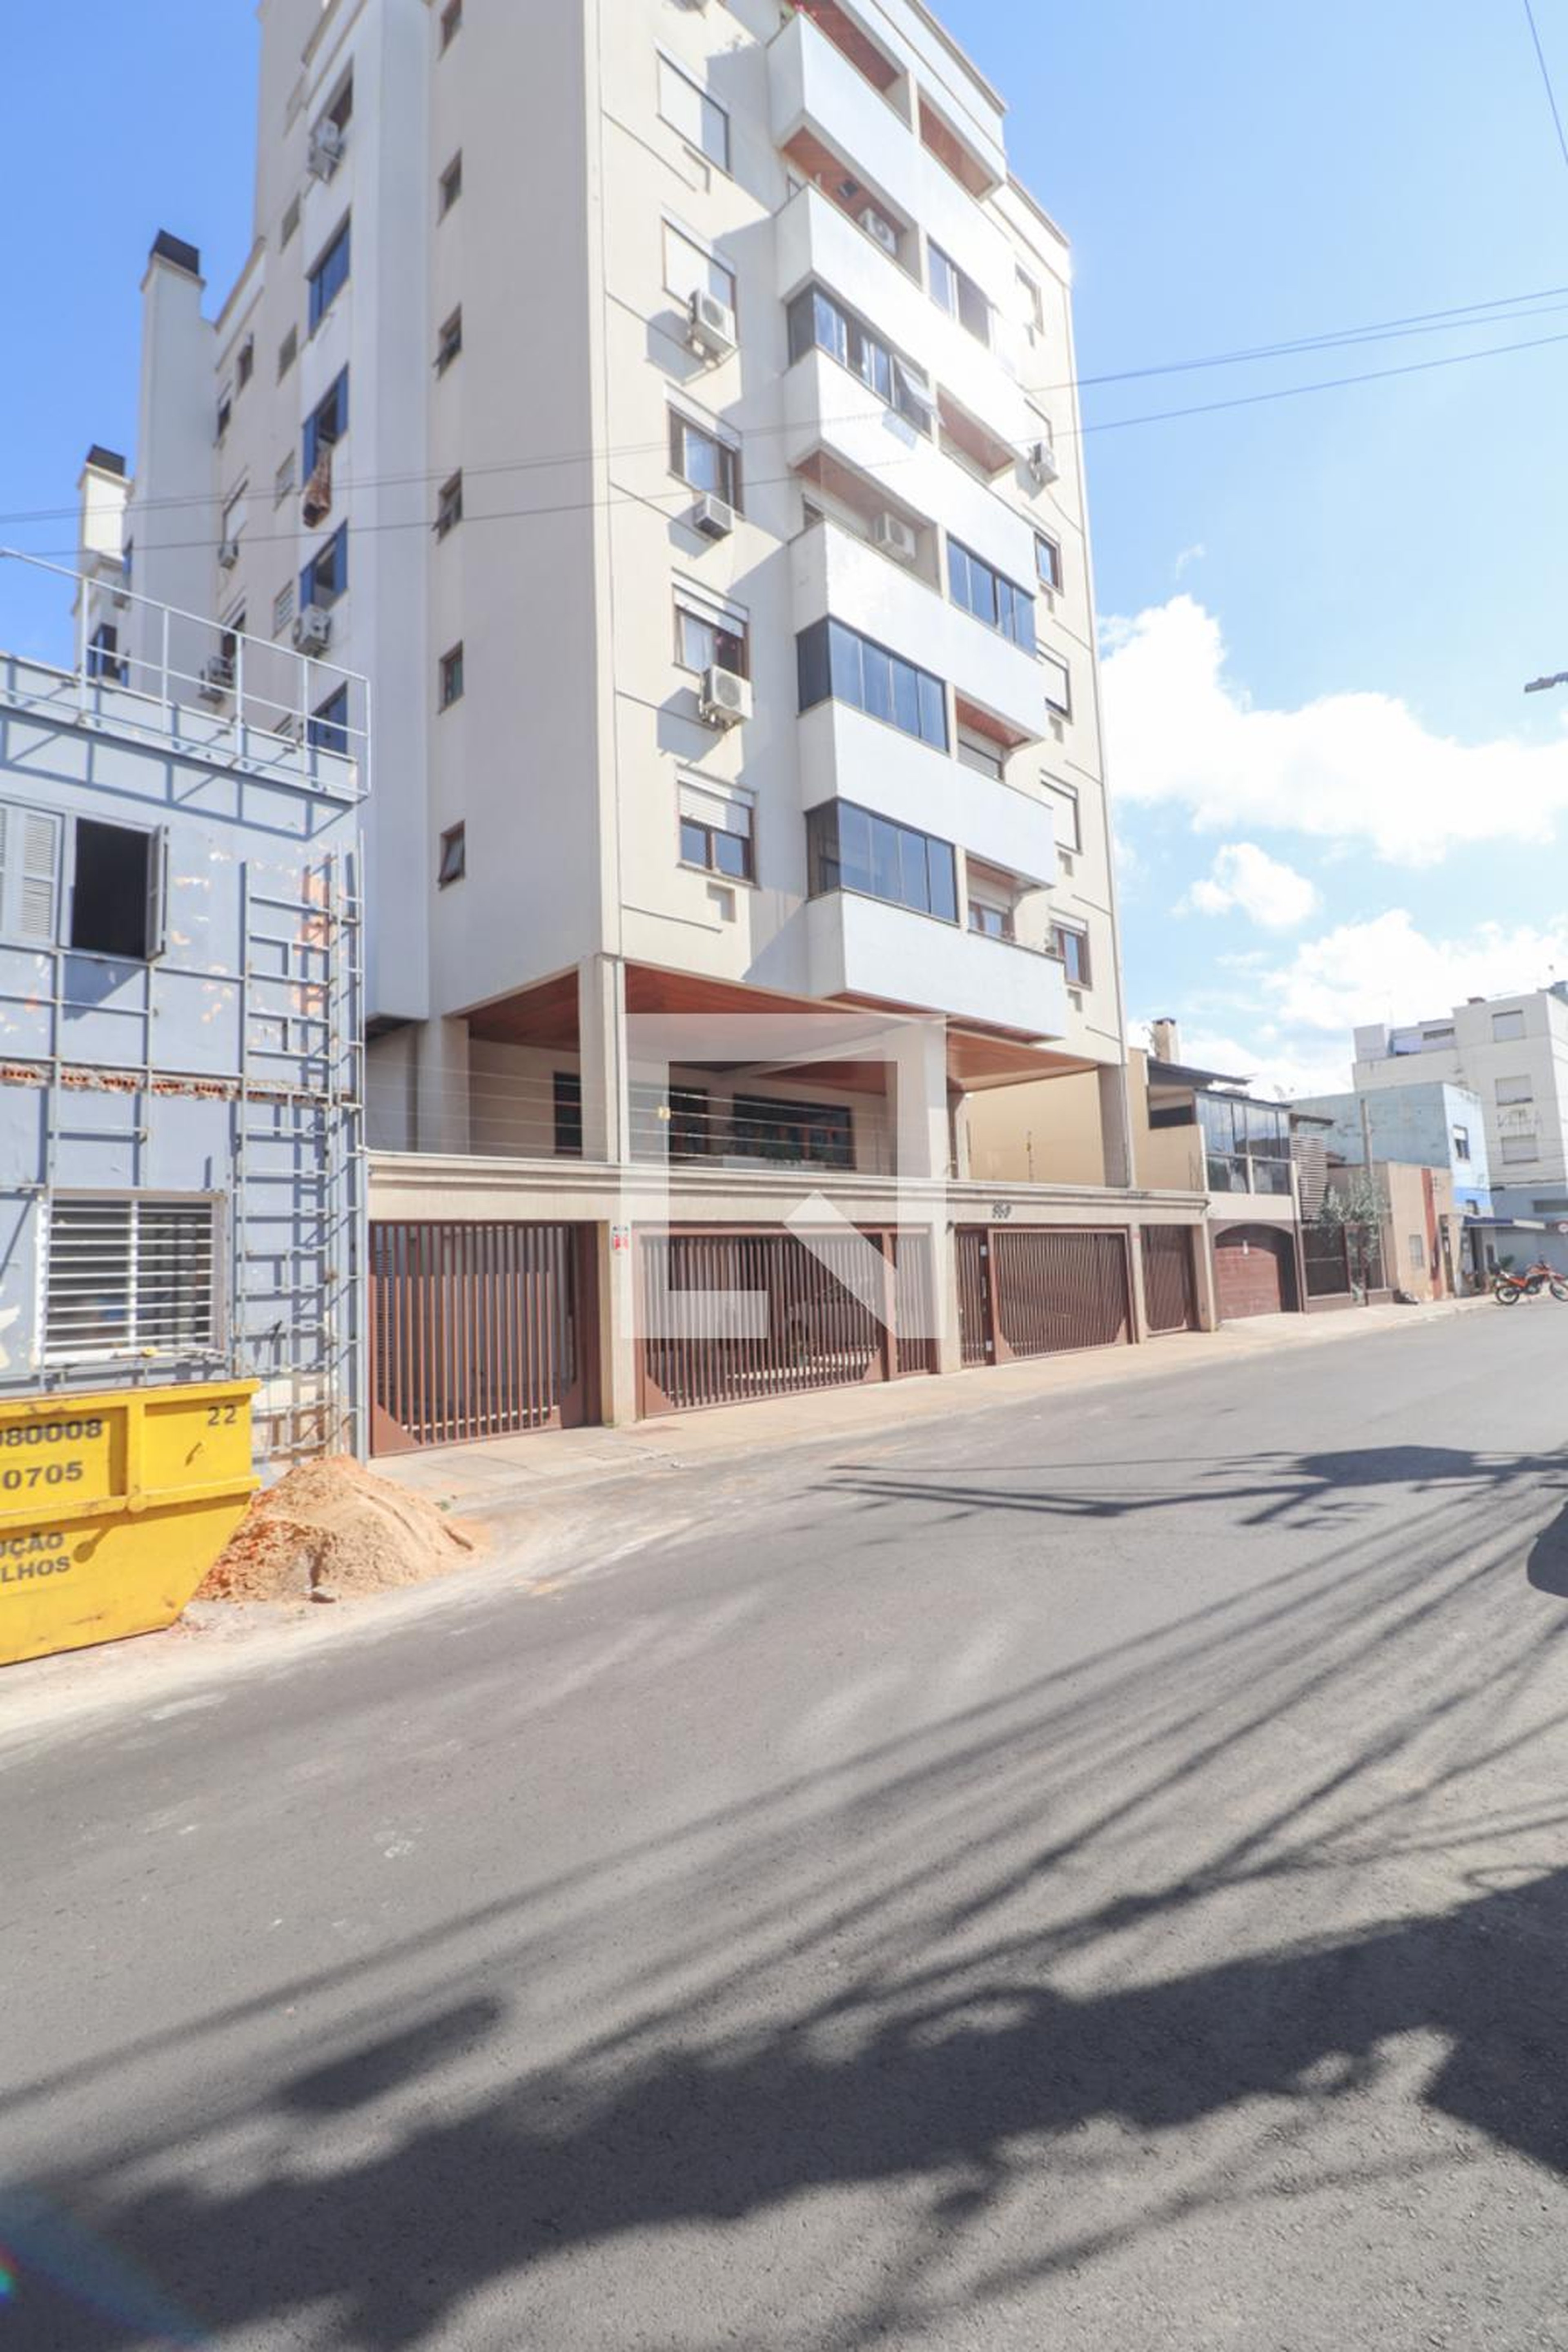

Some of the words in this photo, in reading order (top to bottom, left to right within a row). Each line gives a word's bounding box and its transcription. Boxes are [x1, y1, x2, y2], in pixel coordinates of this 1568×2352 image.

[208, 1405, 236, 1425] 22
[0, 1419, 102, 1447] 80008
[3, 1461, 83, 1490] 0705
[2, 1556, 70, 1582] LHOS
